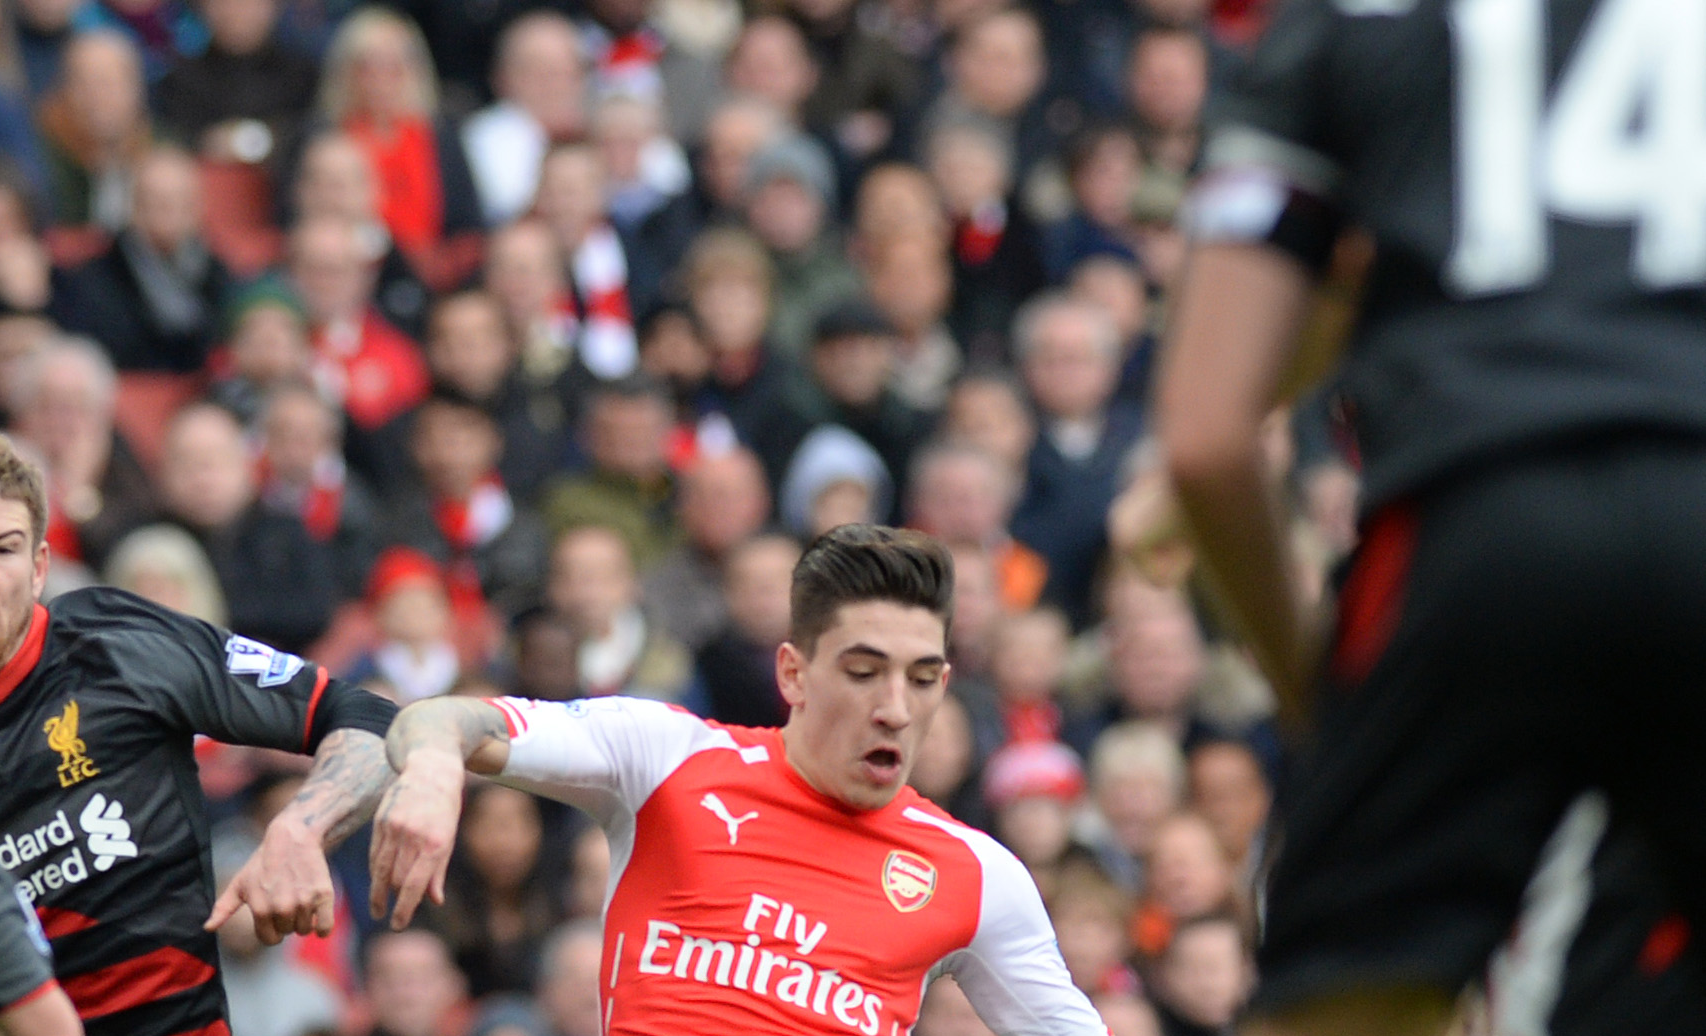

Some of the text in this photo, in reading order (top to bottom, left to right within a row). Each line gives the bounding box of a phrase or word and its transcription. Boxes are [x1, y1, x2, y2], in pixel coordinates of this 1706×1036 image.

[1444, 0, 1706, 296] 14
[637, 920, 883, 1036] Emirates
[743, 893, 828, 955] Fly
